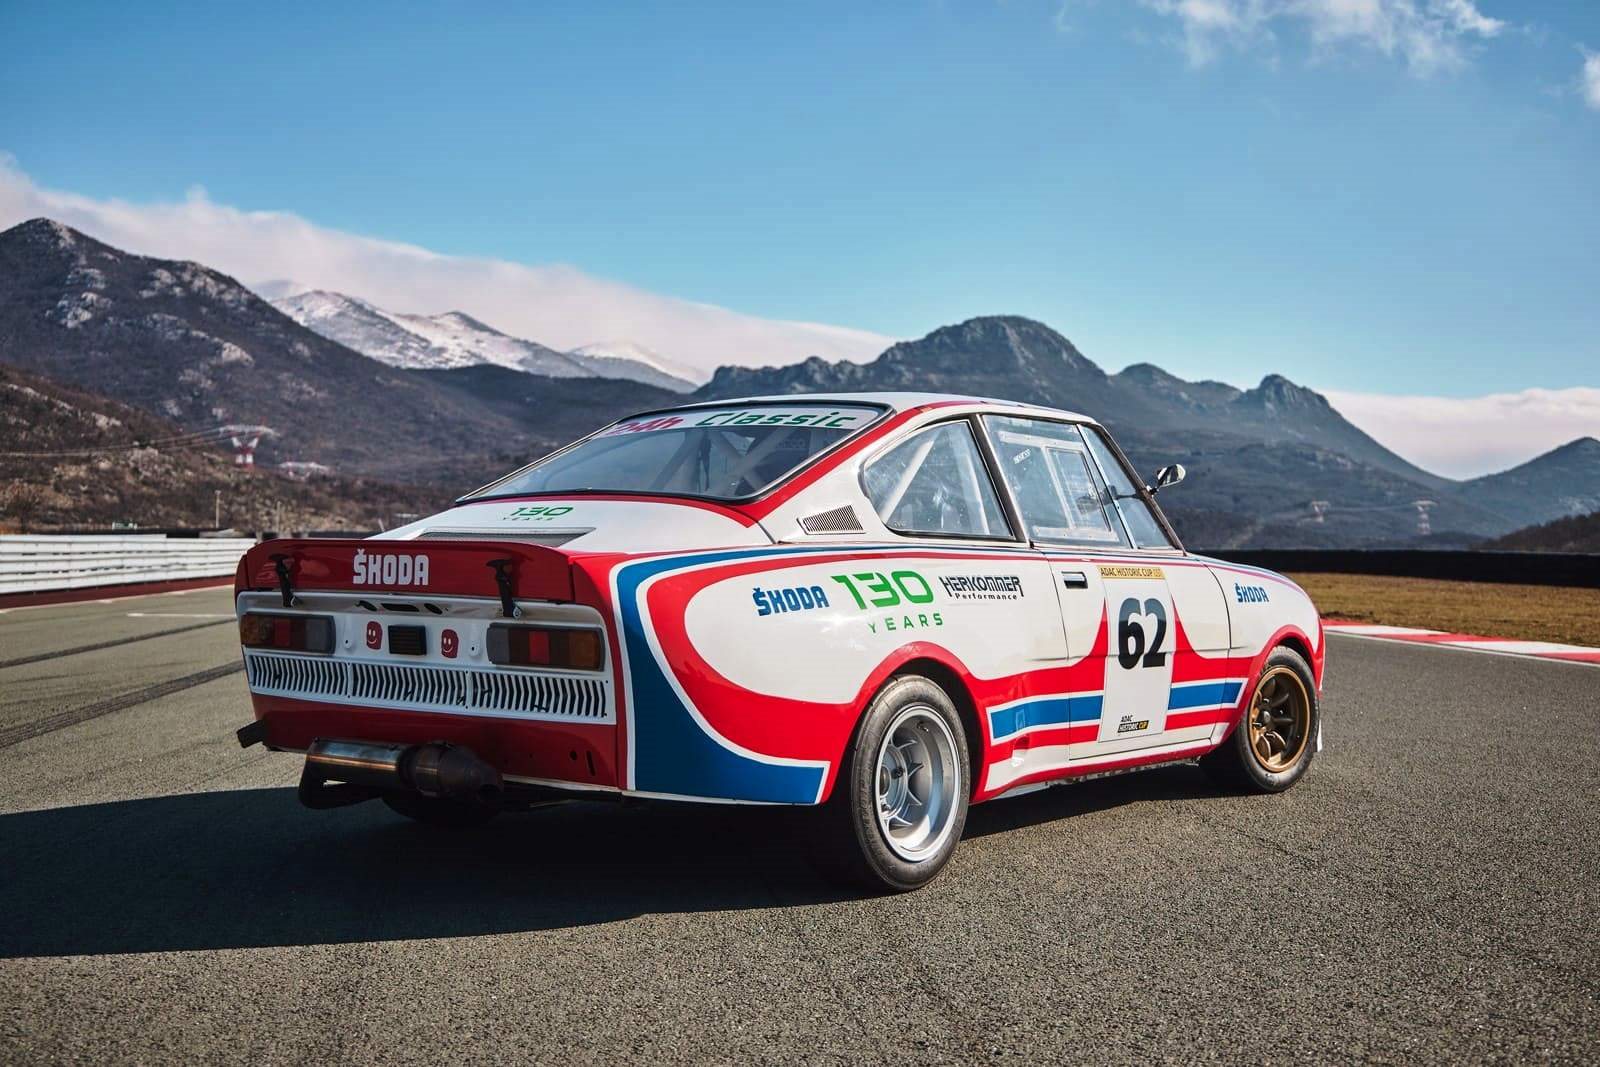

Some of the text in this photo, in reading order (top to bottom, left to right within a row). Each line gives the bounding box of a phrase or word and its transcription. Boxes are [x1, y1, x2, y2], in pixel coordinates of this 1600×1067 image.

[695, 411, 857, 428] Classic
[510, 506, 574, 517] 130
[353, 548, 429, 586] ŠKODA
[1100, 567, 1115, 577] ADAC
[1116, 567, 1141, 577] HISTORIC
[1142, 567, 1153, 577] CUP
[830, 570, 935, 610] 130
[938, 575, 1024, 598] HERKOMMER
[954, 592, 1018, 600] Performance
[1234, 582, 1270, 603] ŠKODA
[752, 585, 830, 617] ŠKODA
[868, 612, 944, 634] YEARS
[1118, 597, 1167, 670] 62
